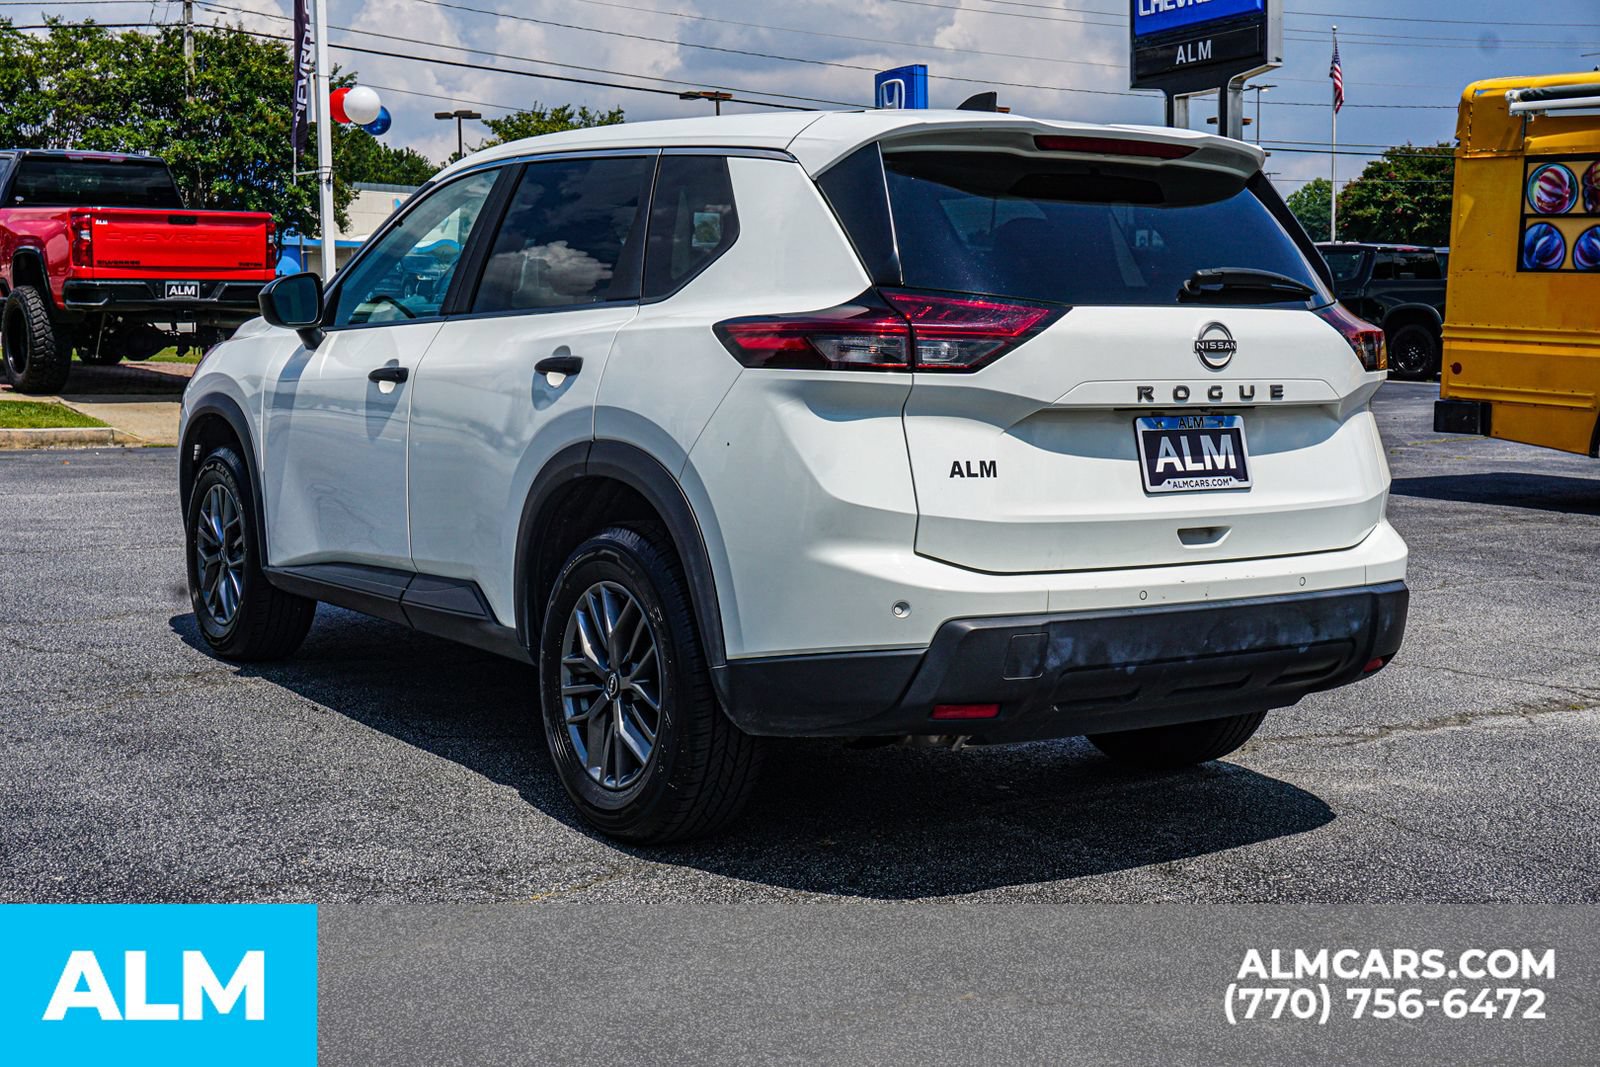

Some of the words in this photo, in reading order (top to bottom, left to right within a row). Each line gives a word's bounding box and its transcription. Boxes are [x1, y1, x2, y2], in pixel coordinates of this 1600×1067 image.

[1175, 40, 1212, 65] ALM
[169, 285, 196, 296] ALM
[1196, 341, 1238, 350] NISSAN
[1137, 384, 1284, 402] ROGUE
[1178, 416, 1205, 429] ALM
[1155, 434, 1237, 473] ALM
[949, 460, 997, 478] ALM
[1172, 477, 1230, 489] ALMCARS.COM
